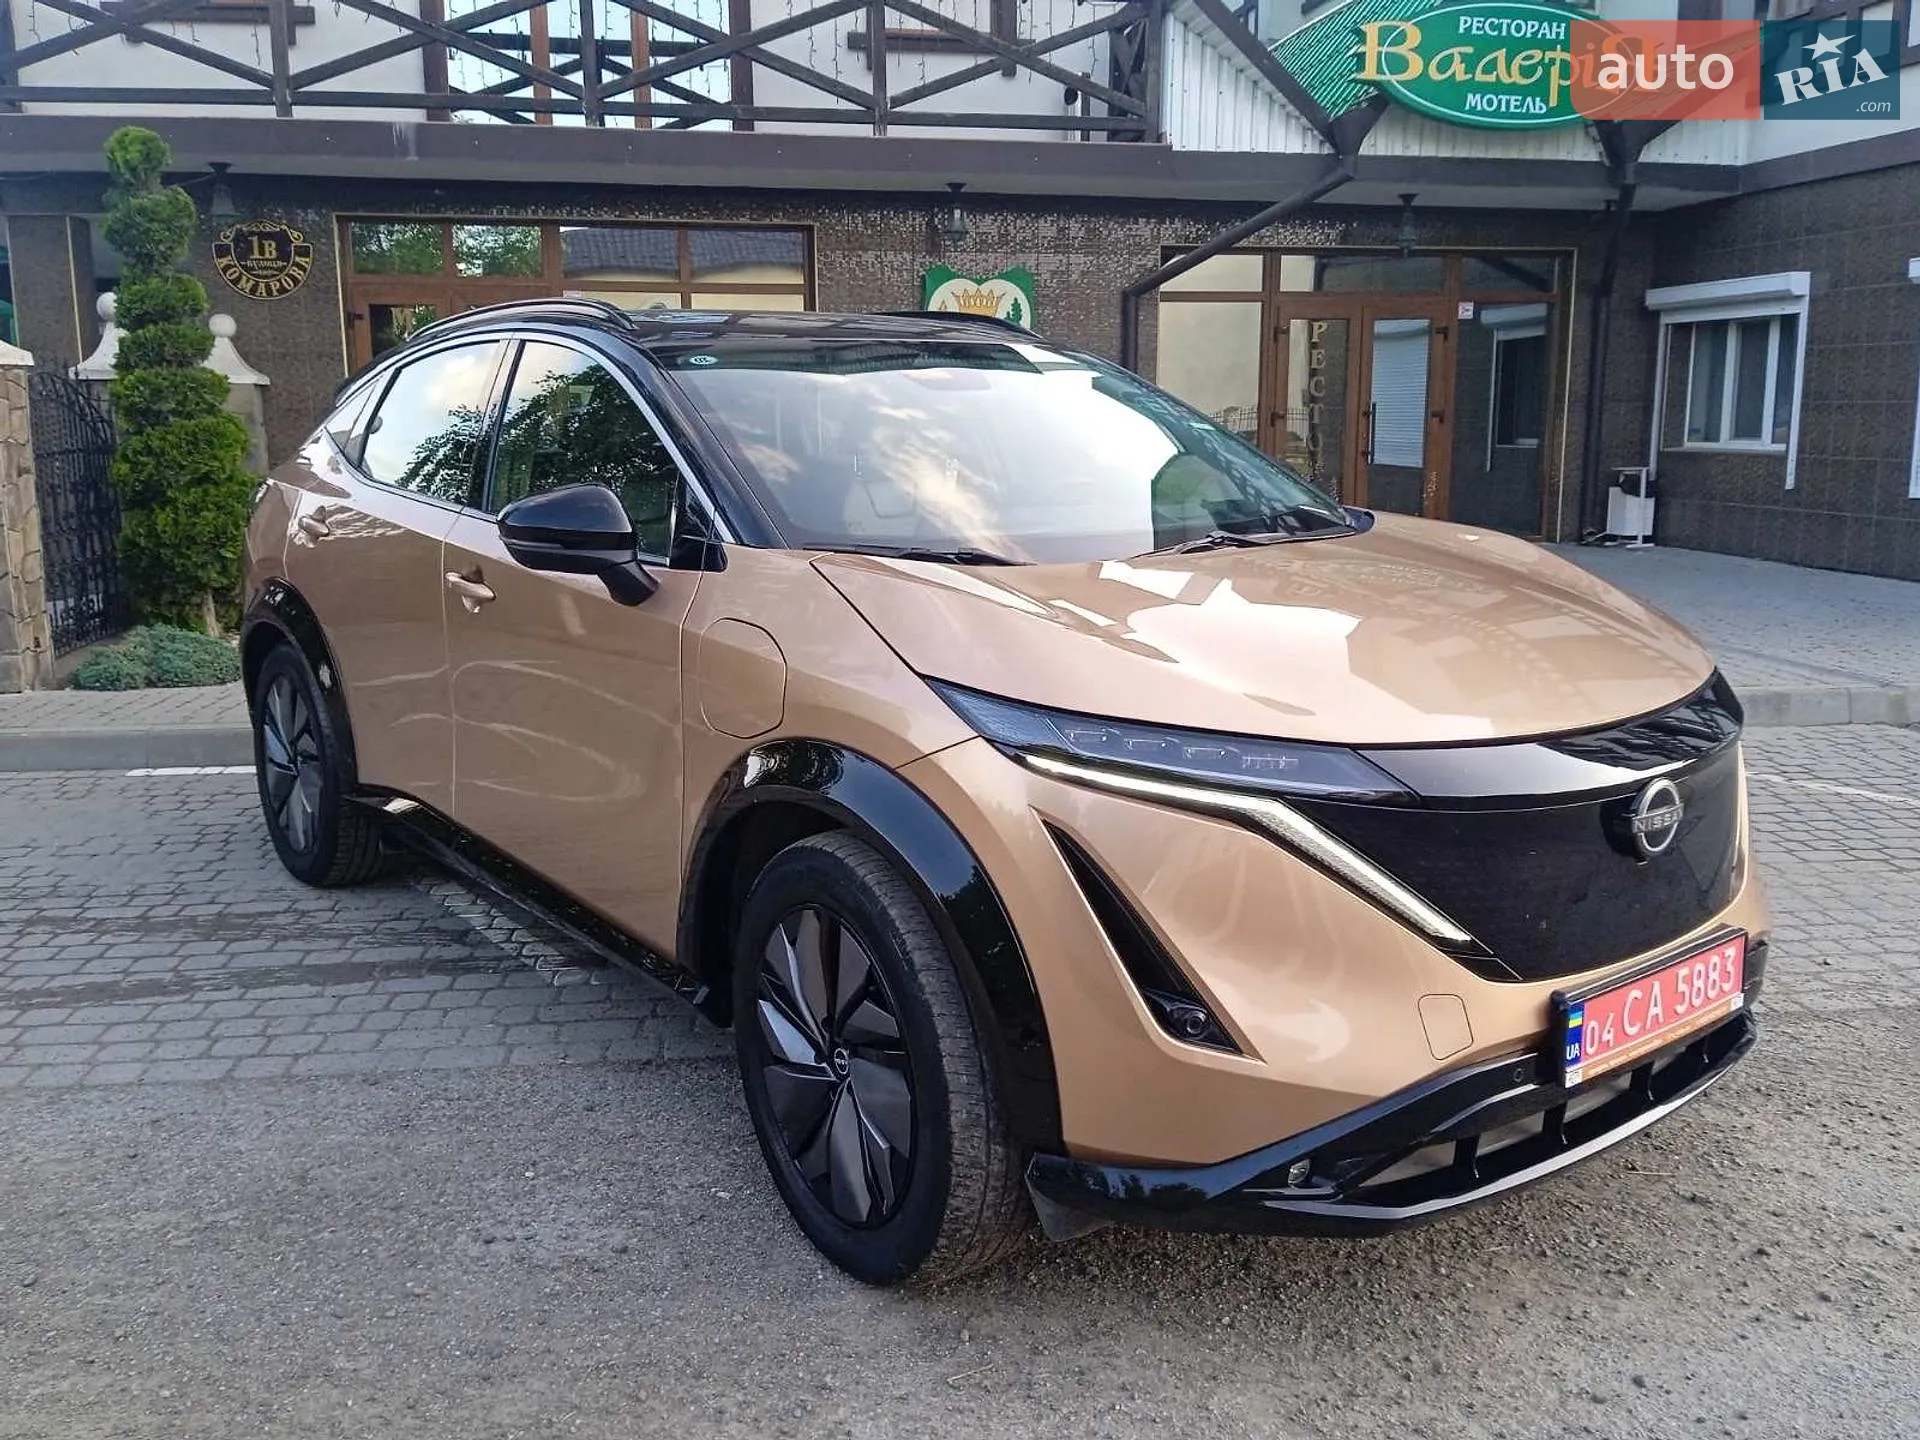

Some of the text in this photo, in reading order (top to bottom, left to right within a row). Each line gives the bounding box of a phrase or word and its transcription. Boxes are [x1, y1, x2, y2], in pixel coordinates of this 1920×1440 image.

[1458, 16, 1566, 40] РЕСТОРАН
[1465, 93, 1547, 114] МОТЕЛЬ
[216, 255, 311, 297] КОМАРОВА
[1307, 321, 1328, 466] РЕСТО
[1584, 1012, 1615, 1055] 04
[1622, 980, 1665, 1036] CA
[1674, 946, 1737, 1015] 5883
[1566, 1043, 1581, 1060] UA
